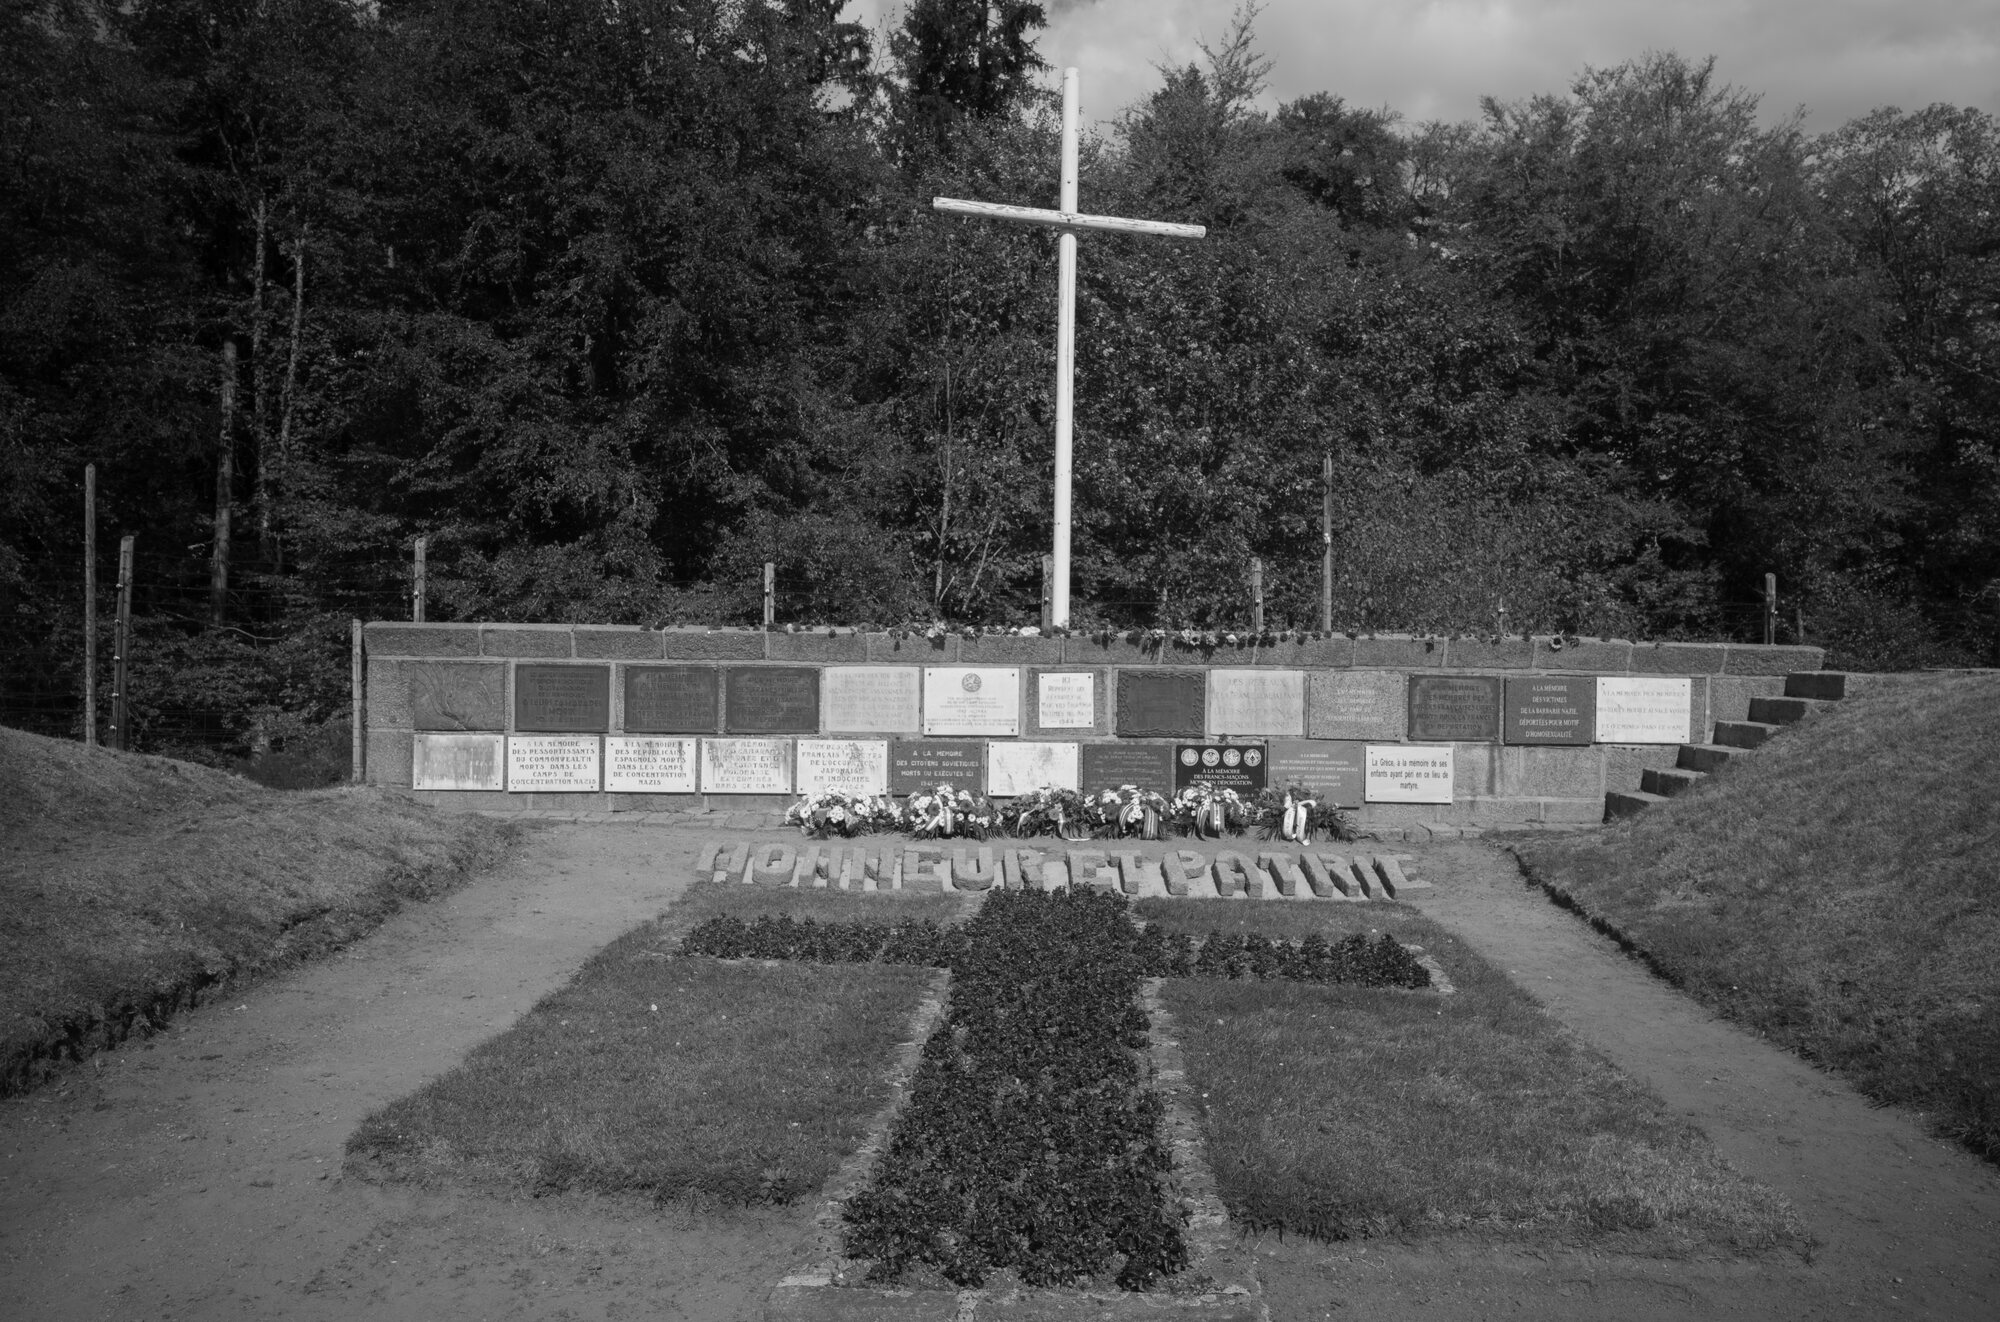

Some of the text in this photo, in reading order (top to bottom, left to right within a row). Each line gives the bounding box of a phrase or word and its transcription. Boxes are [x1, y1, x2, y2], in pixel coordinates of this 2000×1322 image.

[1371, 759, 1378, 767] La
[1402, 759, 1408, 767] la
[1430, 760, 1438, 768] de
[1370, 769, 1388, 778] enfants
[1390, 770, 1404, 780] ayant
[1431, 770, 1441, 779] lieu
[1442, 771, 1449, 779] de
[696, 840, 1432, 900] HONNEUR ET PATRIE
